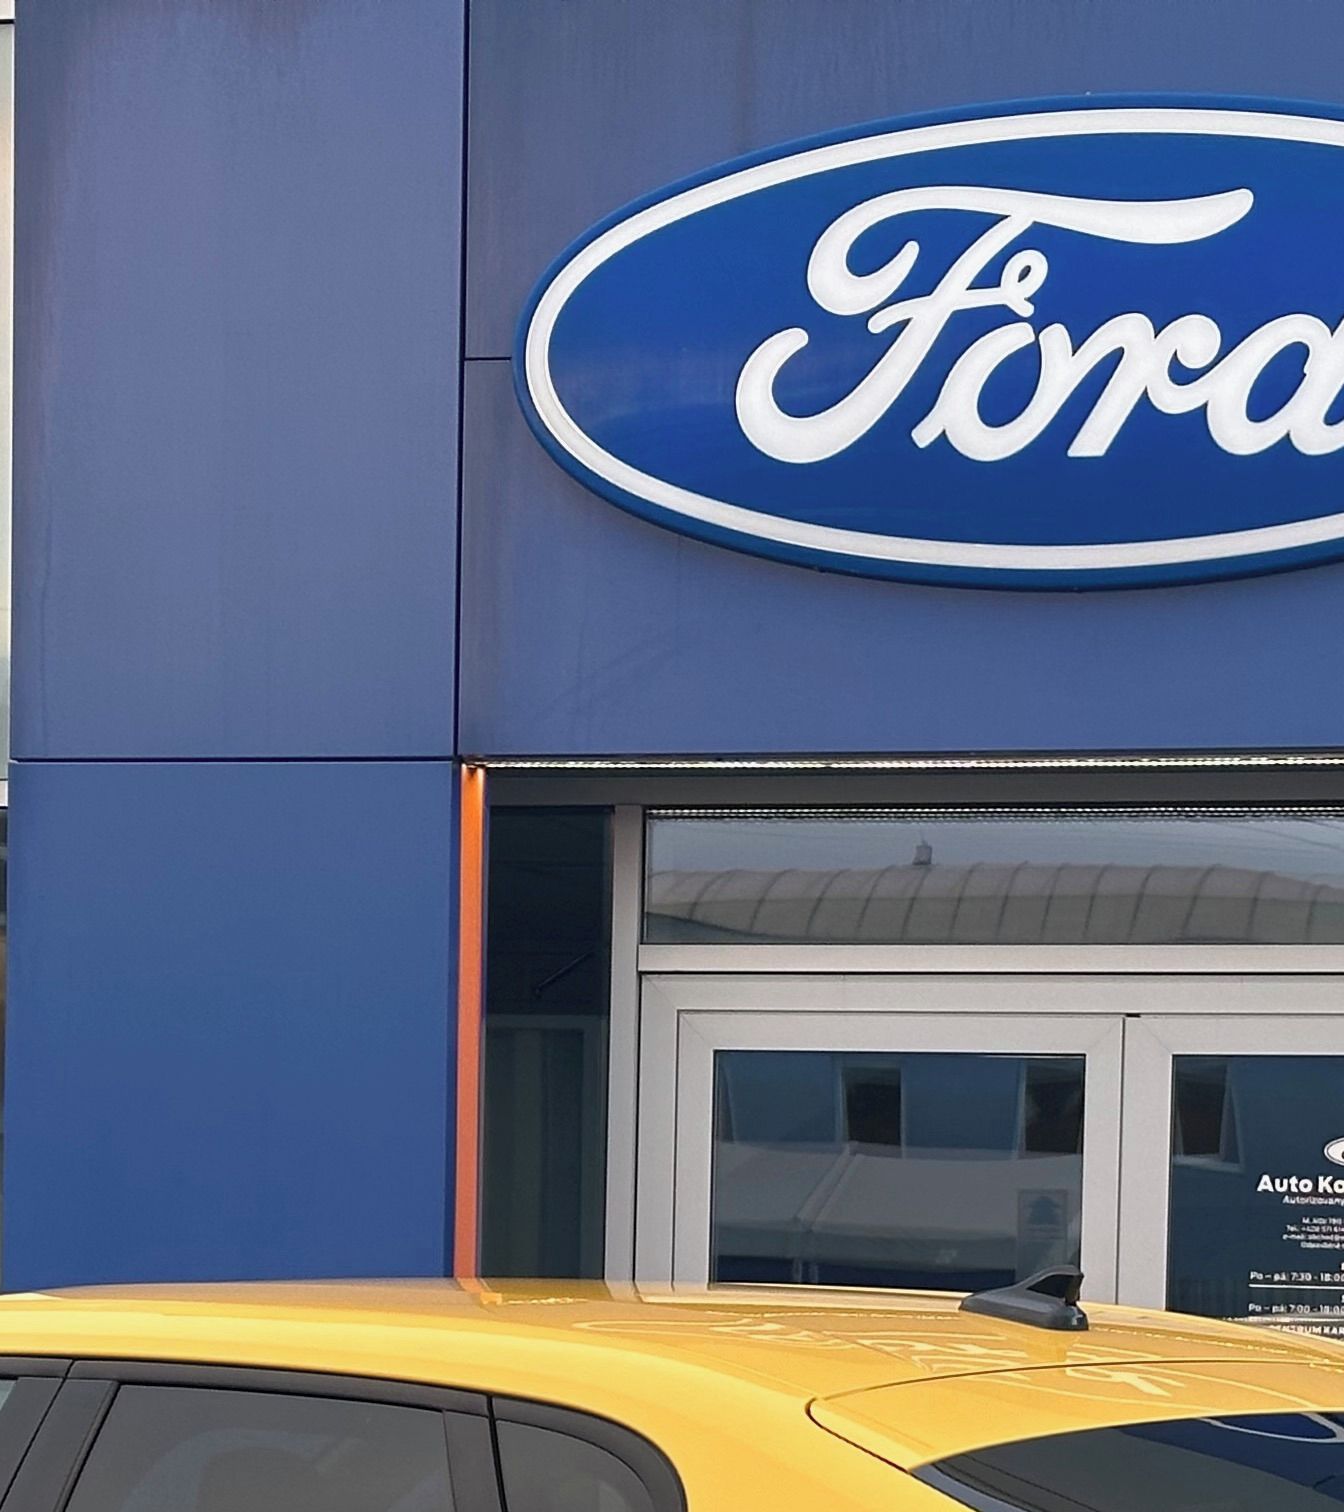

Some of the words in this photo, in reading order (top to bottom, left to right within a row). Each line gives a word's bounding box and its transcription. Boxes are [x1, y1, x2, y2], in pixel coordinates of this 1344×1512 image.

[1256, 1174, 1313, 1194] Auto
[1250, 1271, 1264, 1280] Po
[1291, 1272, 1312, 1280] 7:30
[1248, 1303, 1262, 1312] Po
